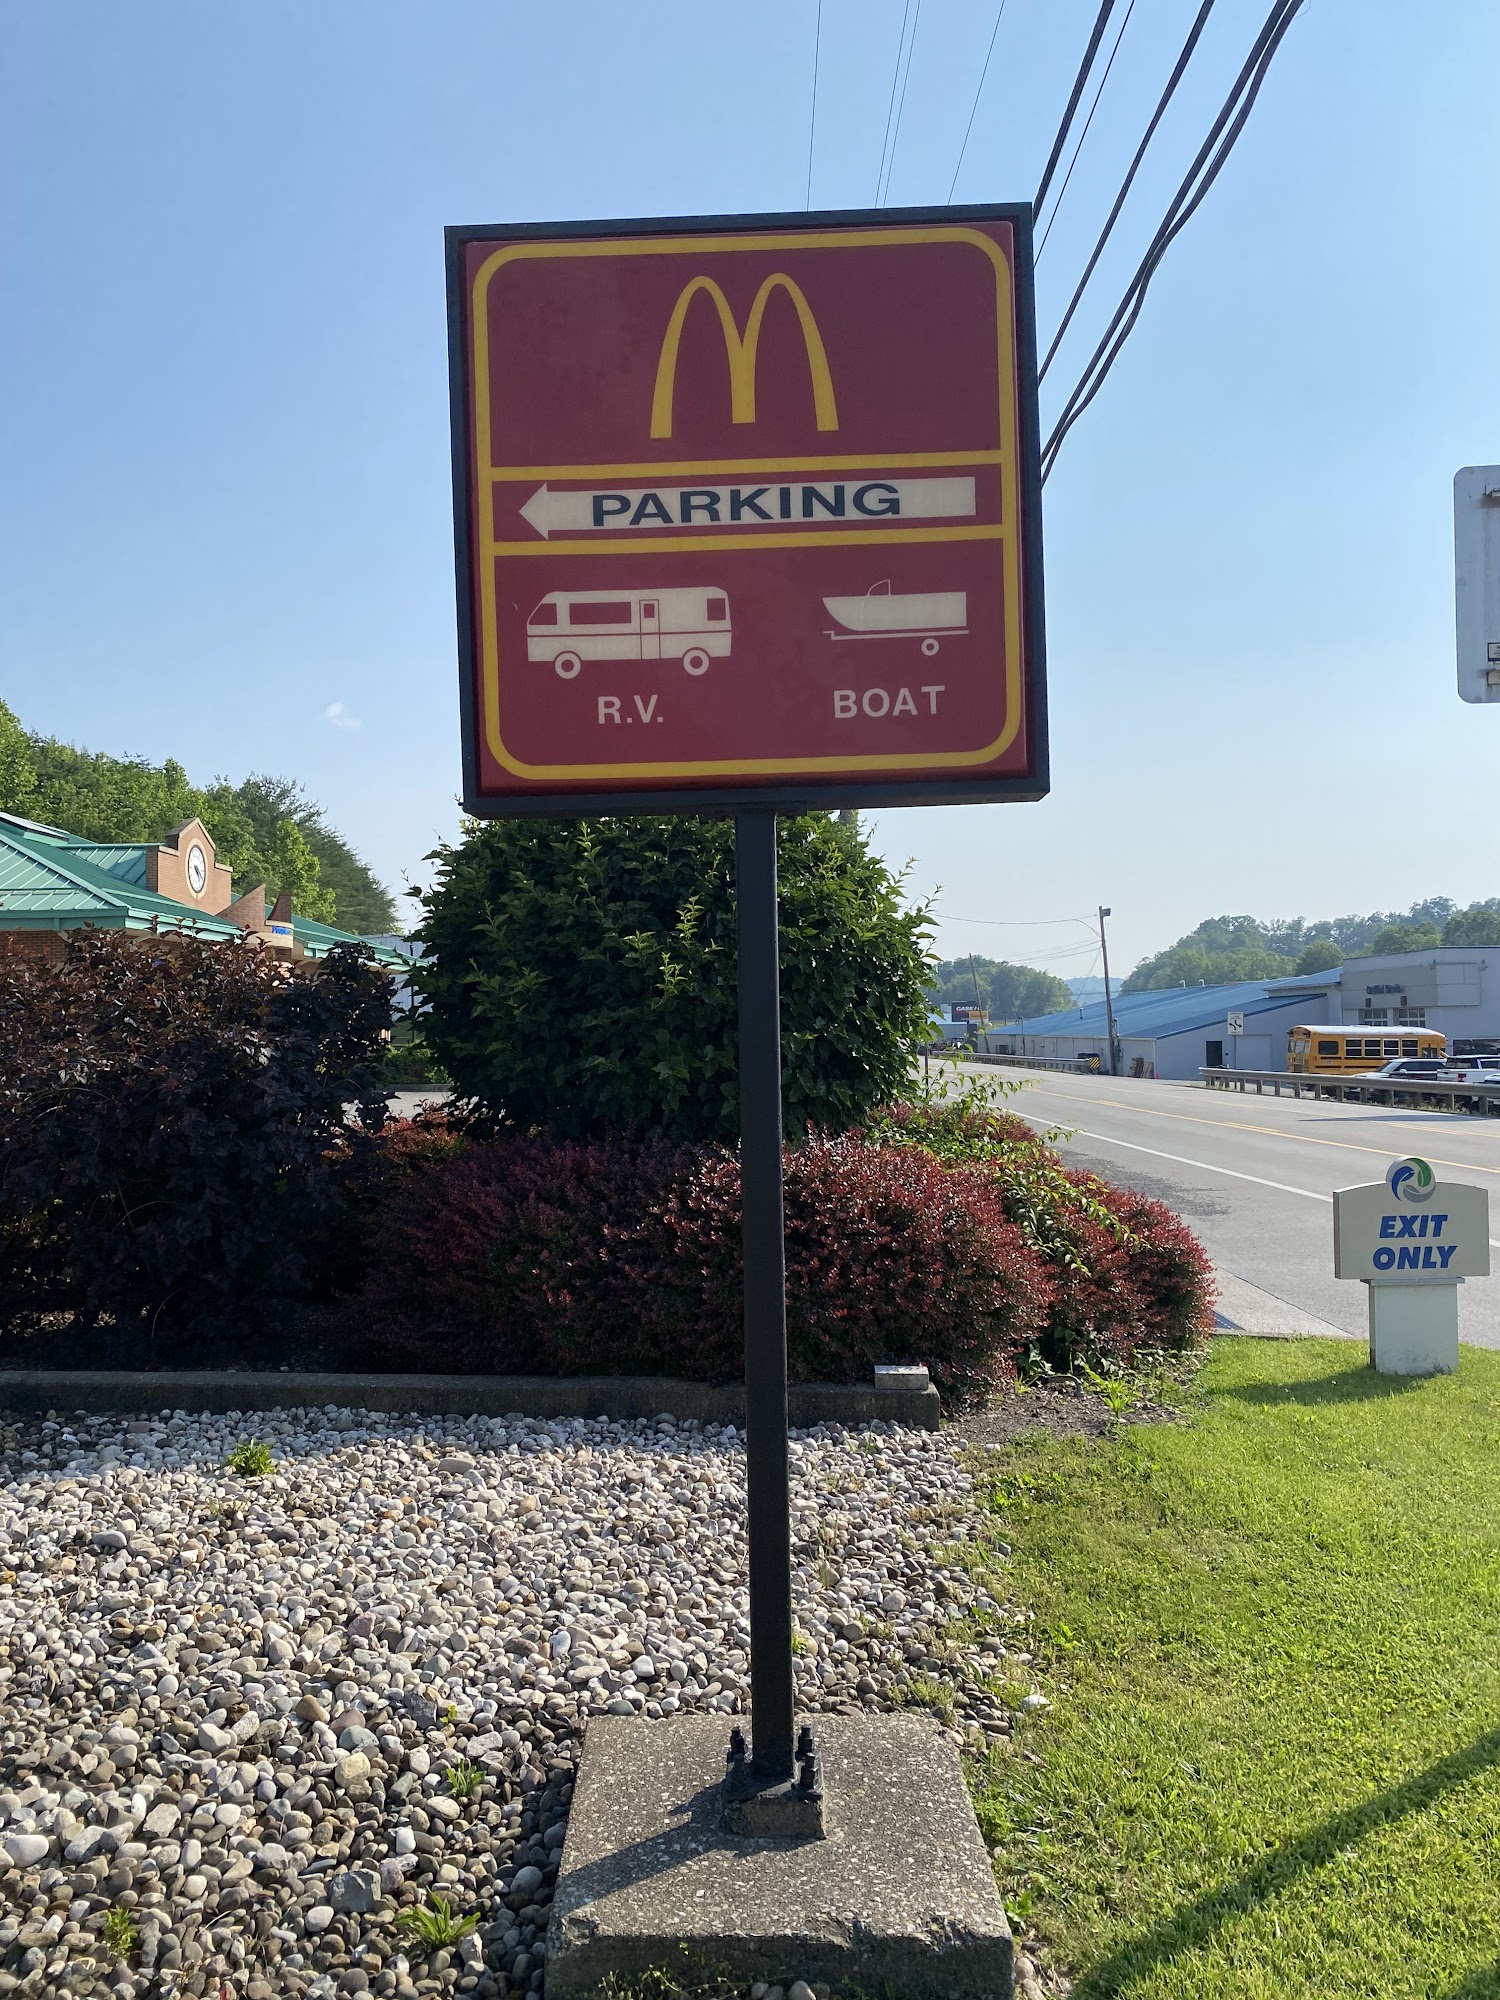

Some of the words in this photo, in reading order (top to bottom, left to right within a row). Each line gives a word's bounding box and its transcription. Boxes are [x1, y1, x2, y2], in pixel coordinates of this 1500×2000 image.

[592, 483, 900, 527] PARKING
[598, 694, 664, 724] R.V.
[833, 685, 945, 718] BOAT
[1379, 1214, 1448, 1238] EXIT
[1372, 1245, 1458, 1270] ONLY
